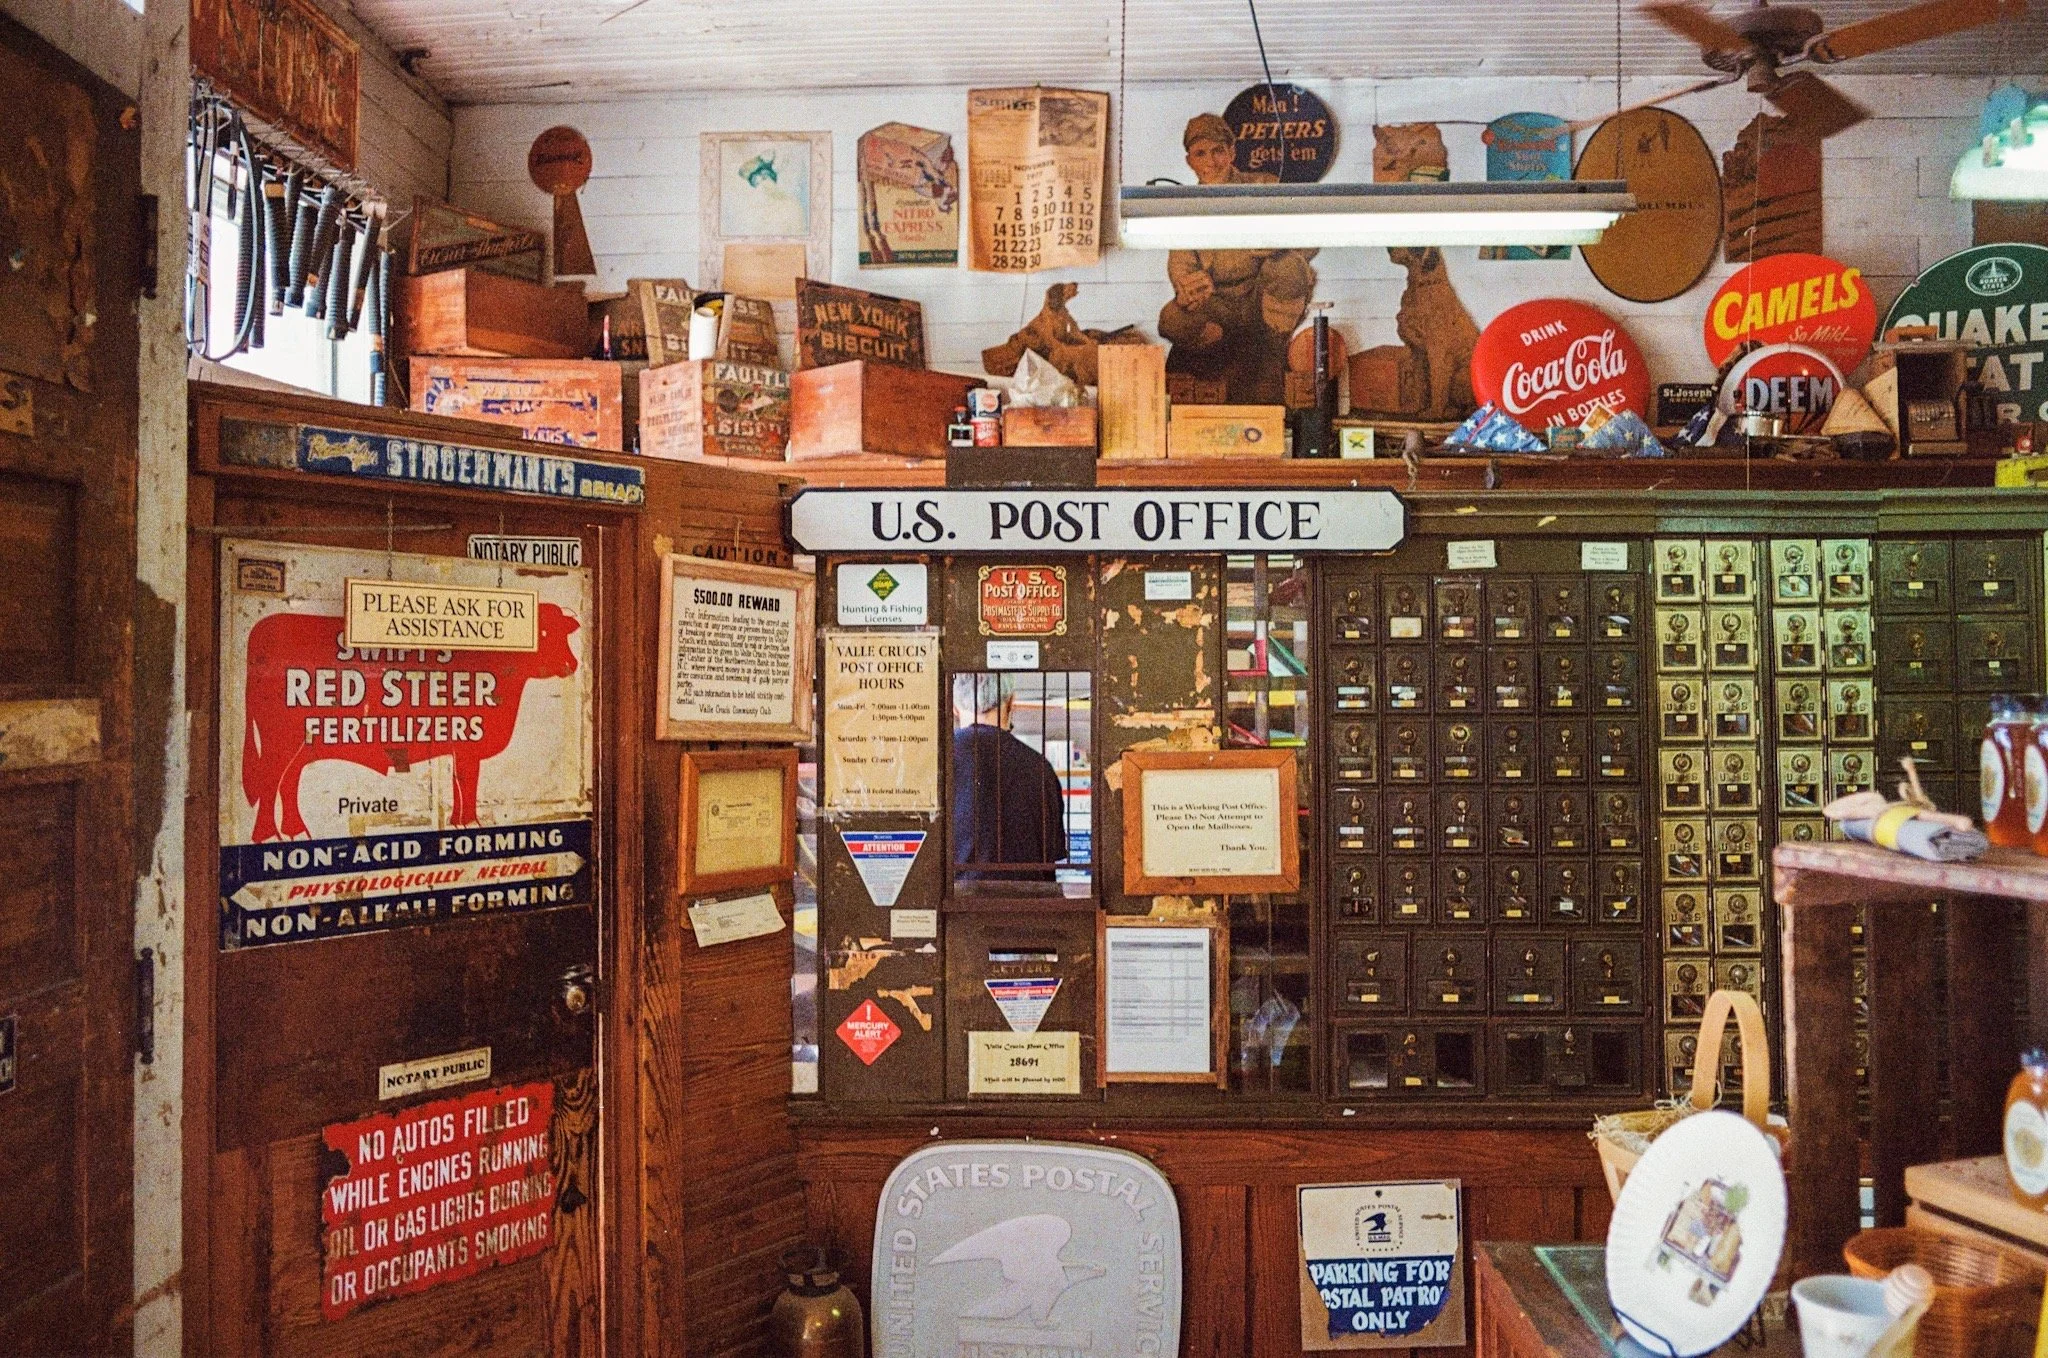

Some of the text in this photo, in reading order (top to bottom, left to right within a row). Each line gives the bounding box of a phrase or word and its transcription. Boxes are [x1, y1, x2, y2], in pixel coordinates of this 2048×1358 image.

[1238, 119, 1326, 140] PETERS
[1249, 146, 1284, 169] gets
[1015, 186, 1091, 204] 1 2 3 4 5
[893, 208, 934, 219] NITRO
[995, 201, 1094, 220] 7 8 9 10 11 12
[884, 221, 943, 233] EXPRESS
[993, 217, 1093, 237] 14 15 16 17 18 19
[993, 233, 1093, 253] 21 22 23 25 26
[992, 254, 1041, 269] 28 29 30
[1979, 276, 2008, 284] QUAKER
[814, 301, 853, 323] NEW
[1712, 267, 1861, 340] CAMELS
[1520, 320, 1568, 347] DRINK
[1789, 325, 1806, 342] So
[821, 332, 906, 360] BISCUIT
[1502, 329, 1627, 414] Coca-Cola
[1746, 376, 1833, 413] DEEM
[1547, 411, 1566, 429] IN
[386, 439, 576, 497] STROEHMANN'S
[580, 479, 643, 504] BREAD
[870, 500, 1322, 543] U.S. POST OFFICE
[473, 540, 580, 568] NOTARY PUBLIC
[1002, 571, 1047, 585] U. S.
[694, 588, 780, 612] $500.00 REWARD
[985, 583, 1060, 599] POST OFFICE
[363, 594, 525, 619] PLEASE ASK FOR
[842, 604, 923, 616] Hunting & Fishing
[733, 612, 749, 625] leading
[864, 614, 902, 623] Licenses
[385, 618, 505, 640] ASSISTANCE
[837, 645, 927, 657] VALLE CRUCIS
[840, 662, 924, 673] POST OFFICE
[286, 668, 497, 708] RED STEER
[859, 678, 904, 690] HOURS
[699, 704, 713, 714] Valle
[760, 706, 771, 716] Club
[304, 714, 484, 746] FERTILIZERS
[838, 735, 867, 744] Saturday
[843, 756, 867, 764] Sunday
[338, 796, 399, 817] Private
[1185, 804, 1220, 812] Working
[1218, 814, 1252, 822] Attempt
[263, 829, 564, 871] NON-ACID FORMING
[863, 843, 905, 852] ATTENTION
[288, 859, 549, 900] PHYSIOLOGICALLY NEUTRAL
[452, 882, 575, 913] FORMING
[991, 964, 1052, 974] LETTERS
[847, 1021, 889, 1030] MERCURY
[854, 1030, 881, 1038] ALERT
[1010, 1057, 1038, 1067] 28691
[386, 1058, 485, 1089] NOTARY PUBLIC
[358, 1096, 530, 1163] NO AUTOS FILLED
[330, 1131, 550, 1215] WHILE ENGINES RUNNING
[897, 1163, 1010, 1219] STATES
[1021, 1164, 1157, 1222] POSTAL
[329, 1170, 553, 1261] OIL OR GAS LIGHTS BURNING
[331, 1214, 548, 1305] OR OCCUPANTS SMOKING
[1309, 1260, 1451, 1286] PARKING FOR
[1352, 1311, 1411, 1330] ONLY
